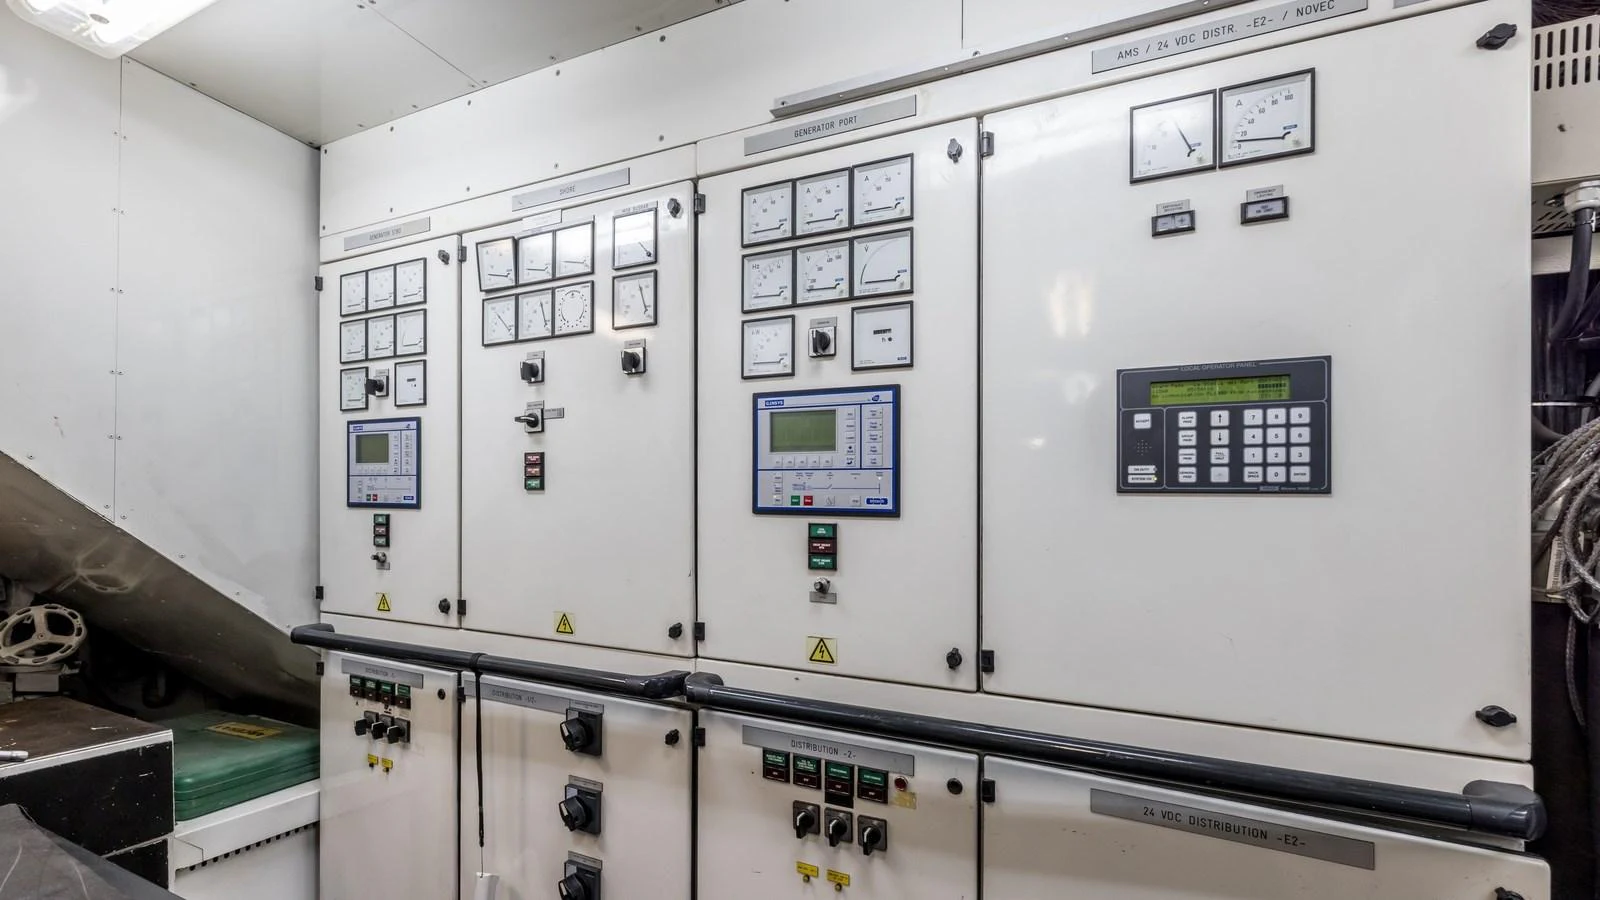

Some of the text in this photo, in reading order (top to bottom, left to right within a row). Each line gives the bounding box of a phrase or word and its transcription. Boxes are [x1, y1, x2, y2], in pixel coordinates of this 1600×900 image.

[1117, 0, 1335, 60] AMS / 24 VDC DISTR. -E2- / NOVEC
[1235, 99, 1243, 108] A
[794, 115, 858, 138] GENERATOR PORT
[559, 184, 576, 196] SHORE
[791, 740, 839, 755] DISTRIBUTION
[1143, 806, 1306, 847] 24 VDC DISTRIBUTION -E2-
